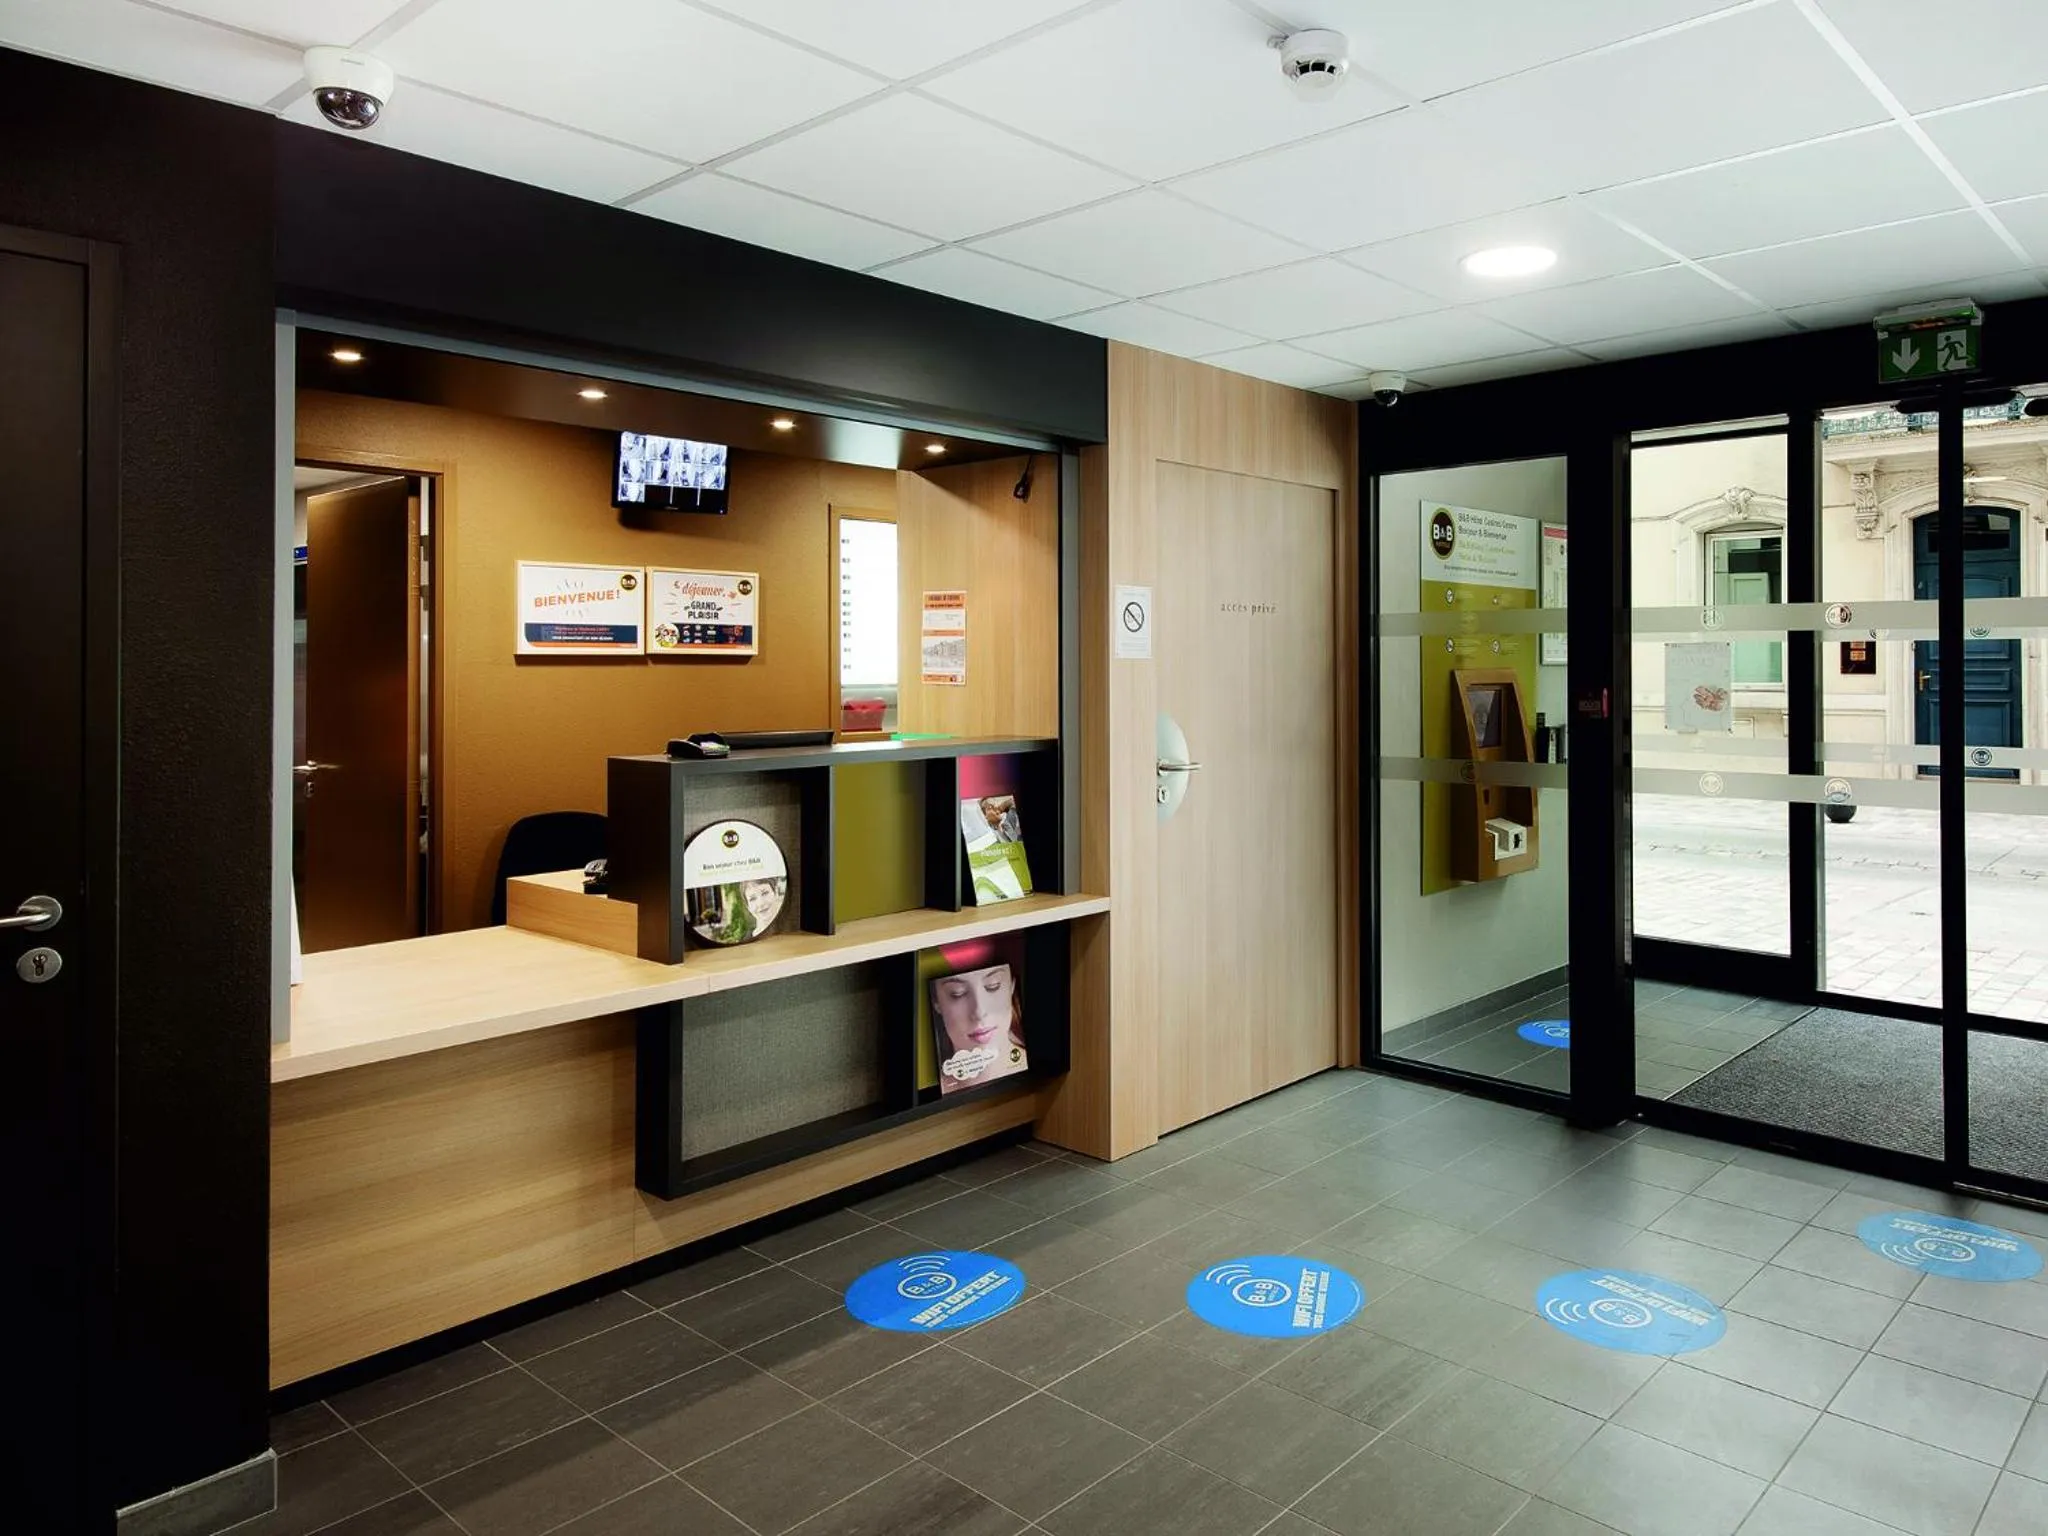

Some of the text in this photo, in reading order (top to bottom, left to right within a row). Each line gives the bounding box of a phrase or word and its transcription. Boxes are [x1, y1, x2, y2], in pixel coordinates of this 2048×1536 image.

[1433, 523, 1453, 541] B&B
[688, 612, 719, 620] PLAISIR
[691, 601, 717, 611] GRAND
[906, 1275, 947, 1295] B&B
[1248, 1281, 1274, 1303] B&B
[910, 1301, 952, 1325] WIFI
[943, 1269, 1001, 1305] OFFERT
[1292, 1267, 1319, 1328] WIFI OFFERT
